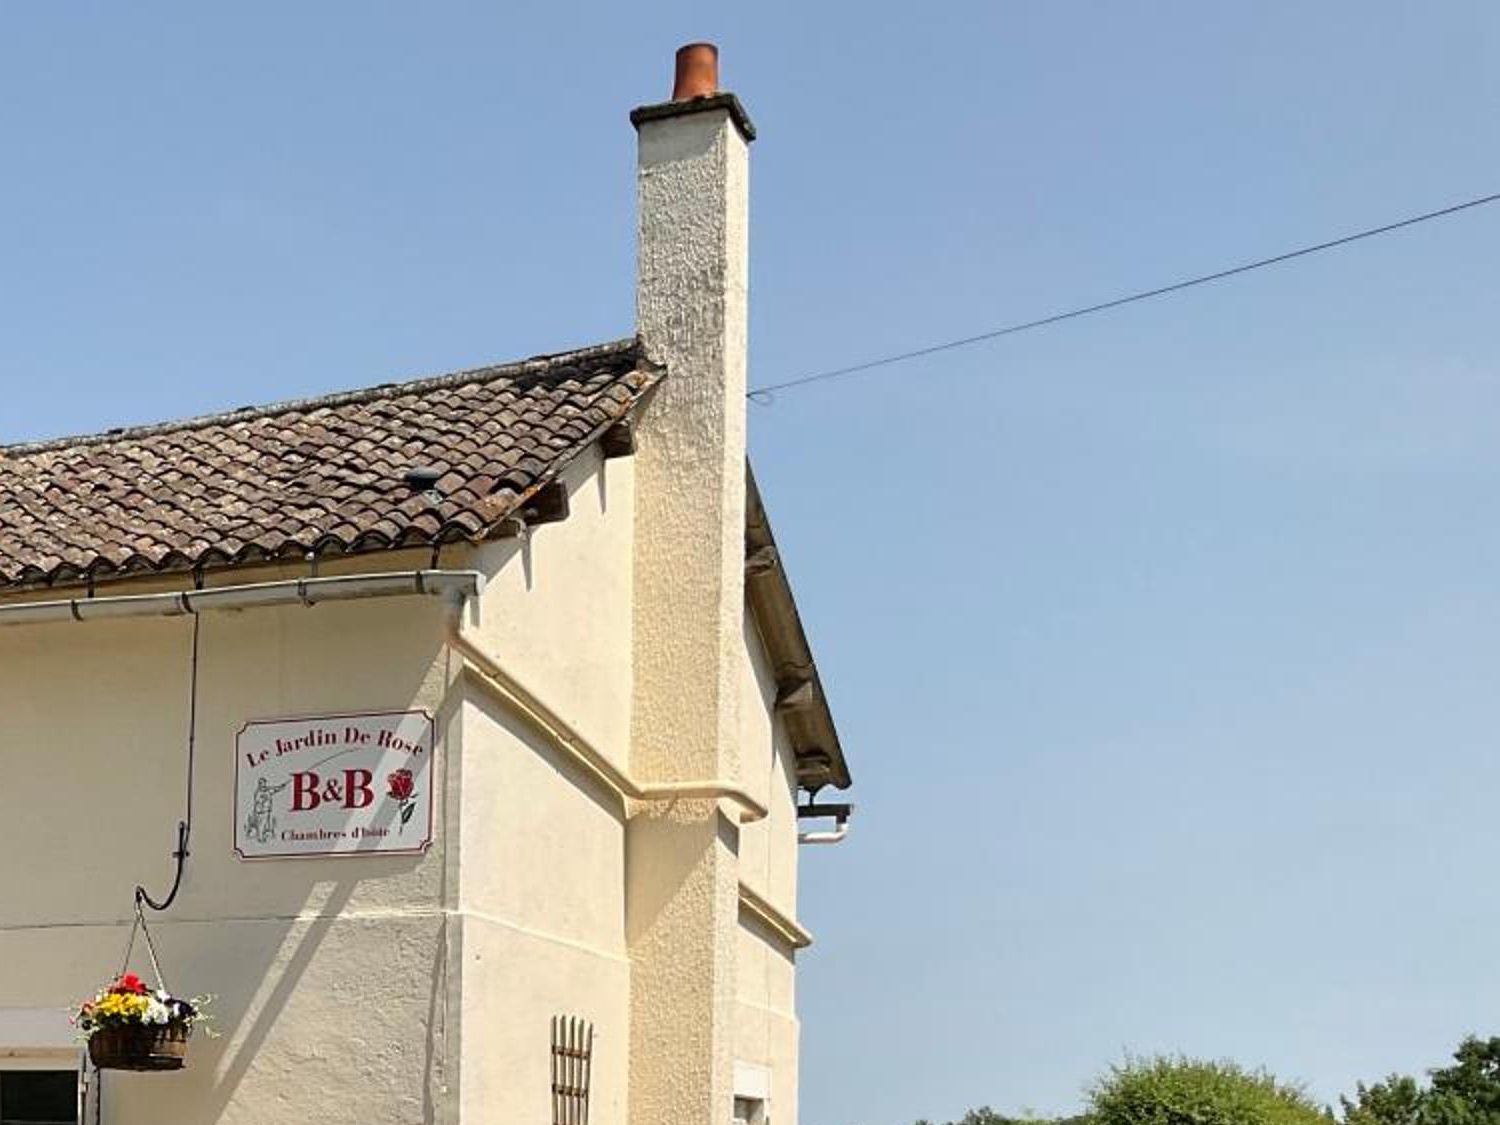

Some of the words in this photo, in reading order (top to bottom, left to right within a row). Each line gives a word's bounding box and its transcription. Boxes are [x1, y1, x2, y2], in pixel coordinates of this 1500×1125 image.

[246, 748, 270, 768] Le
[274, 729, 337, 757] Jardin
[344, 727, 371, 745] De
[377, 729, 424, 757] Rose
[289, 768, 375, 812] B&B
